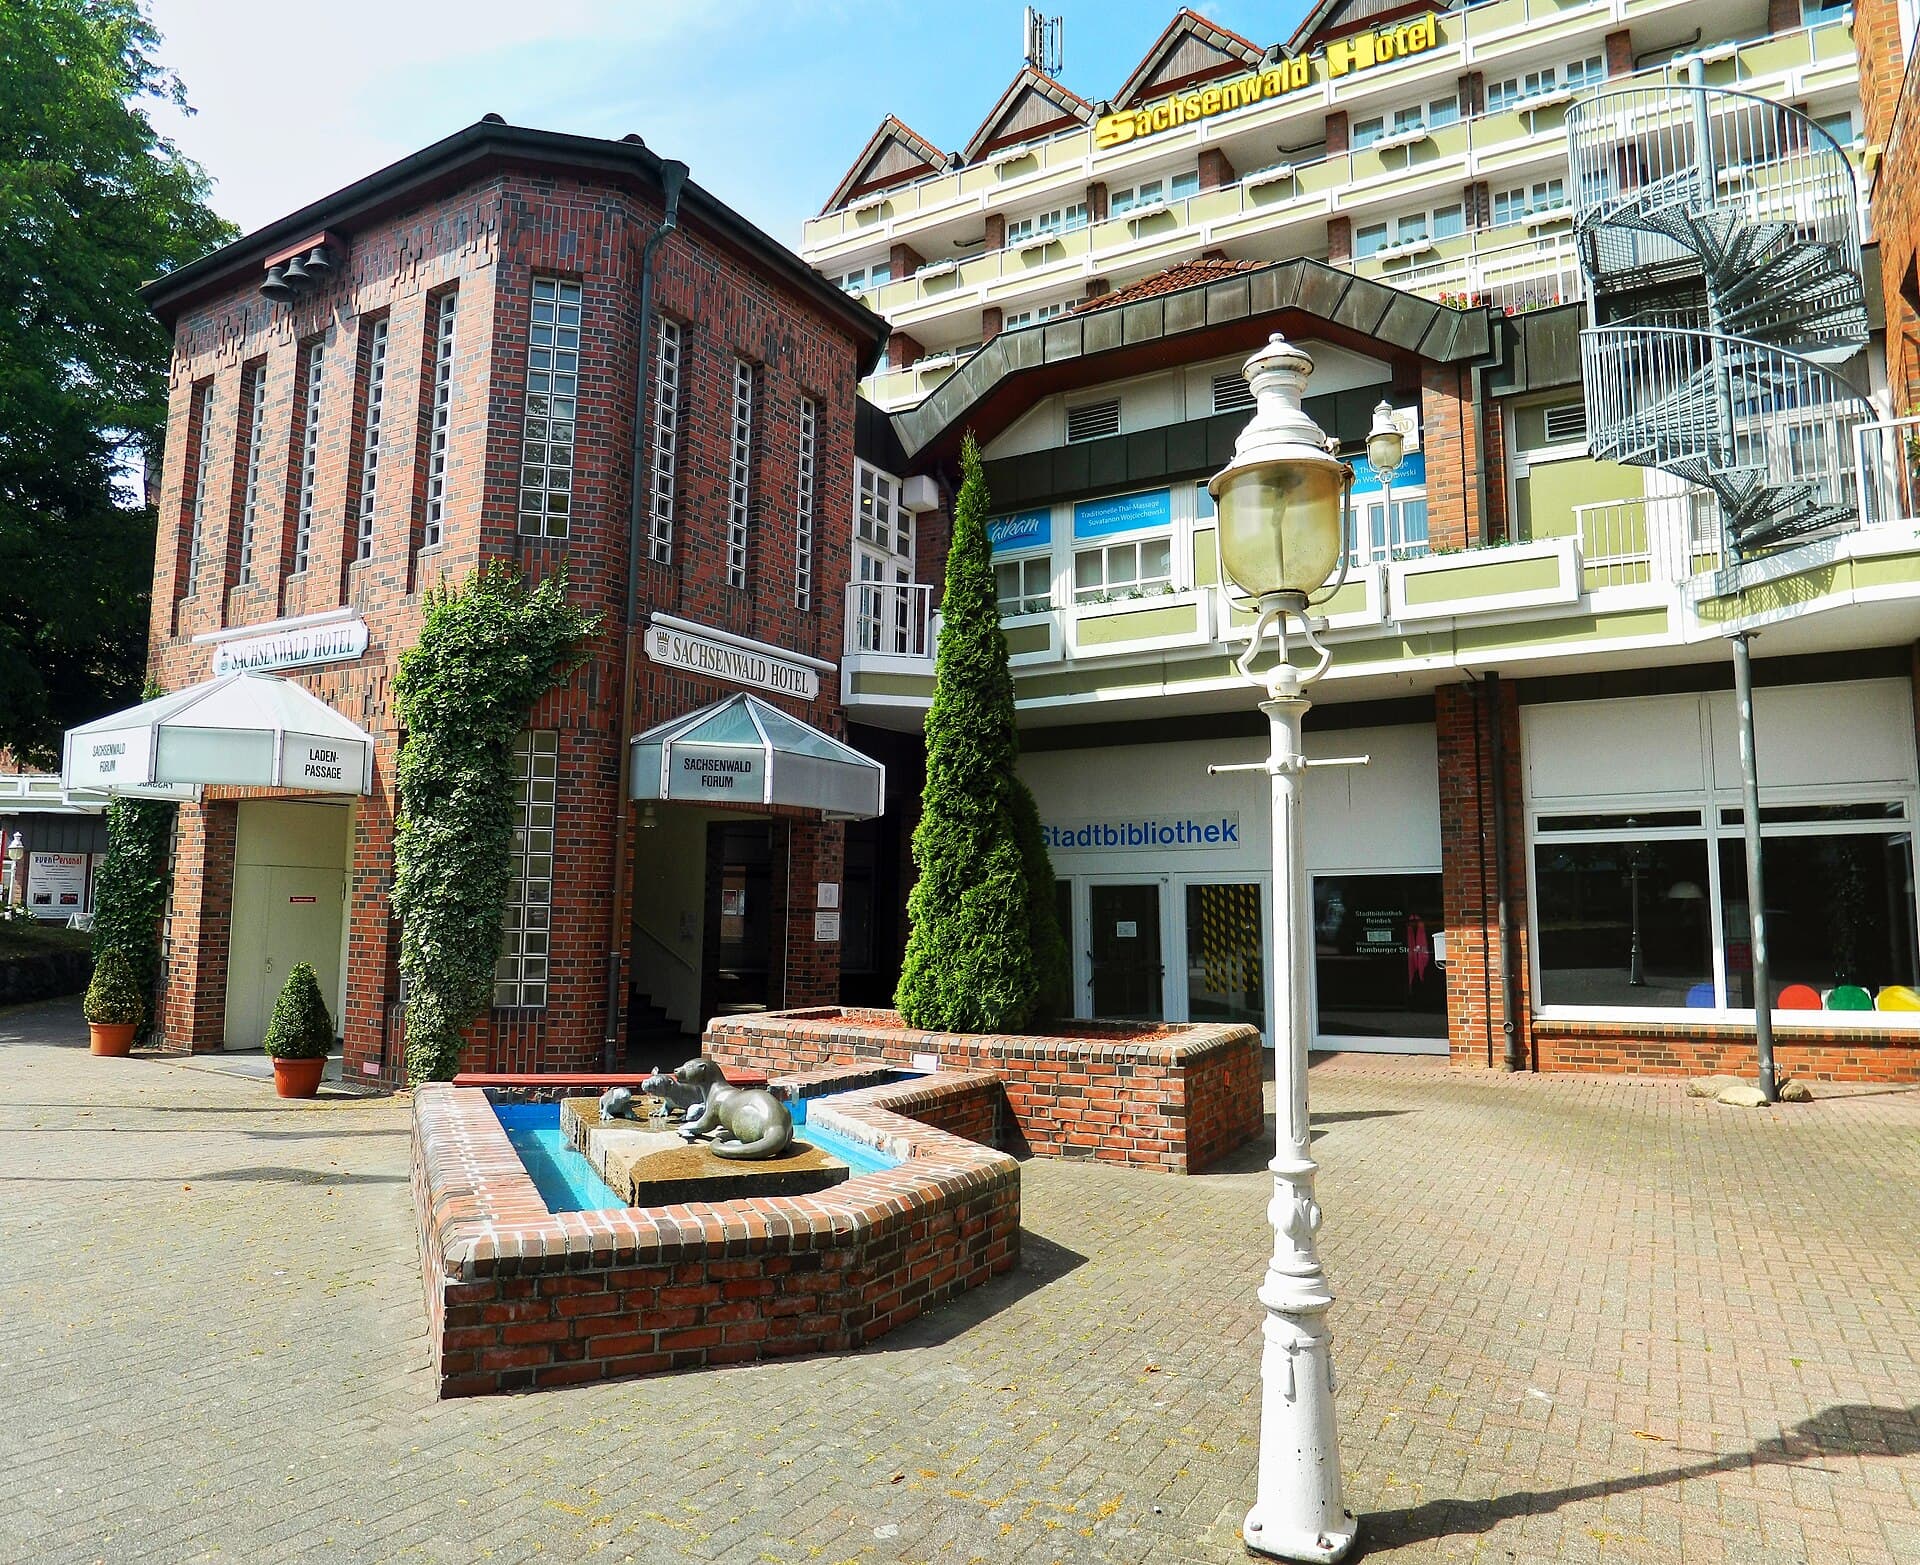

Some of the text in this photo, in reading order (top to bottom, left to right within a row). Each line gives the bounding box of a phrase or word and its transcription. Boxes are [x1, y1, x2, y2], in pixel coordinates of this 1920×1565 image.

[1095, 10, 1437, 149] Sachsenwald Hotel
[1081, 507, 1118, 518] Traditionelle
[231, 629, 354, 670] SACHSENWALD HOTEL
[673, 637, 809, 694] SACHSENWALD HOTEL
[92, 742, 126, 757] SACHSENWALD
[309, 748, 339, 763] LADEN-
[99, 759, 116, 773] FORUM
[304, 764, 342, 780] PASSAGE
[684, 757, 752, 773] SACHSENWALD
[701, 775, 734, 788] FORUM
